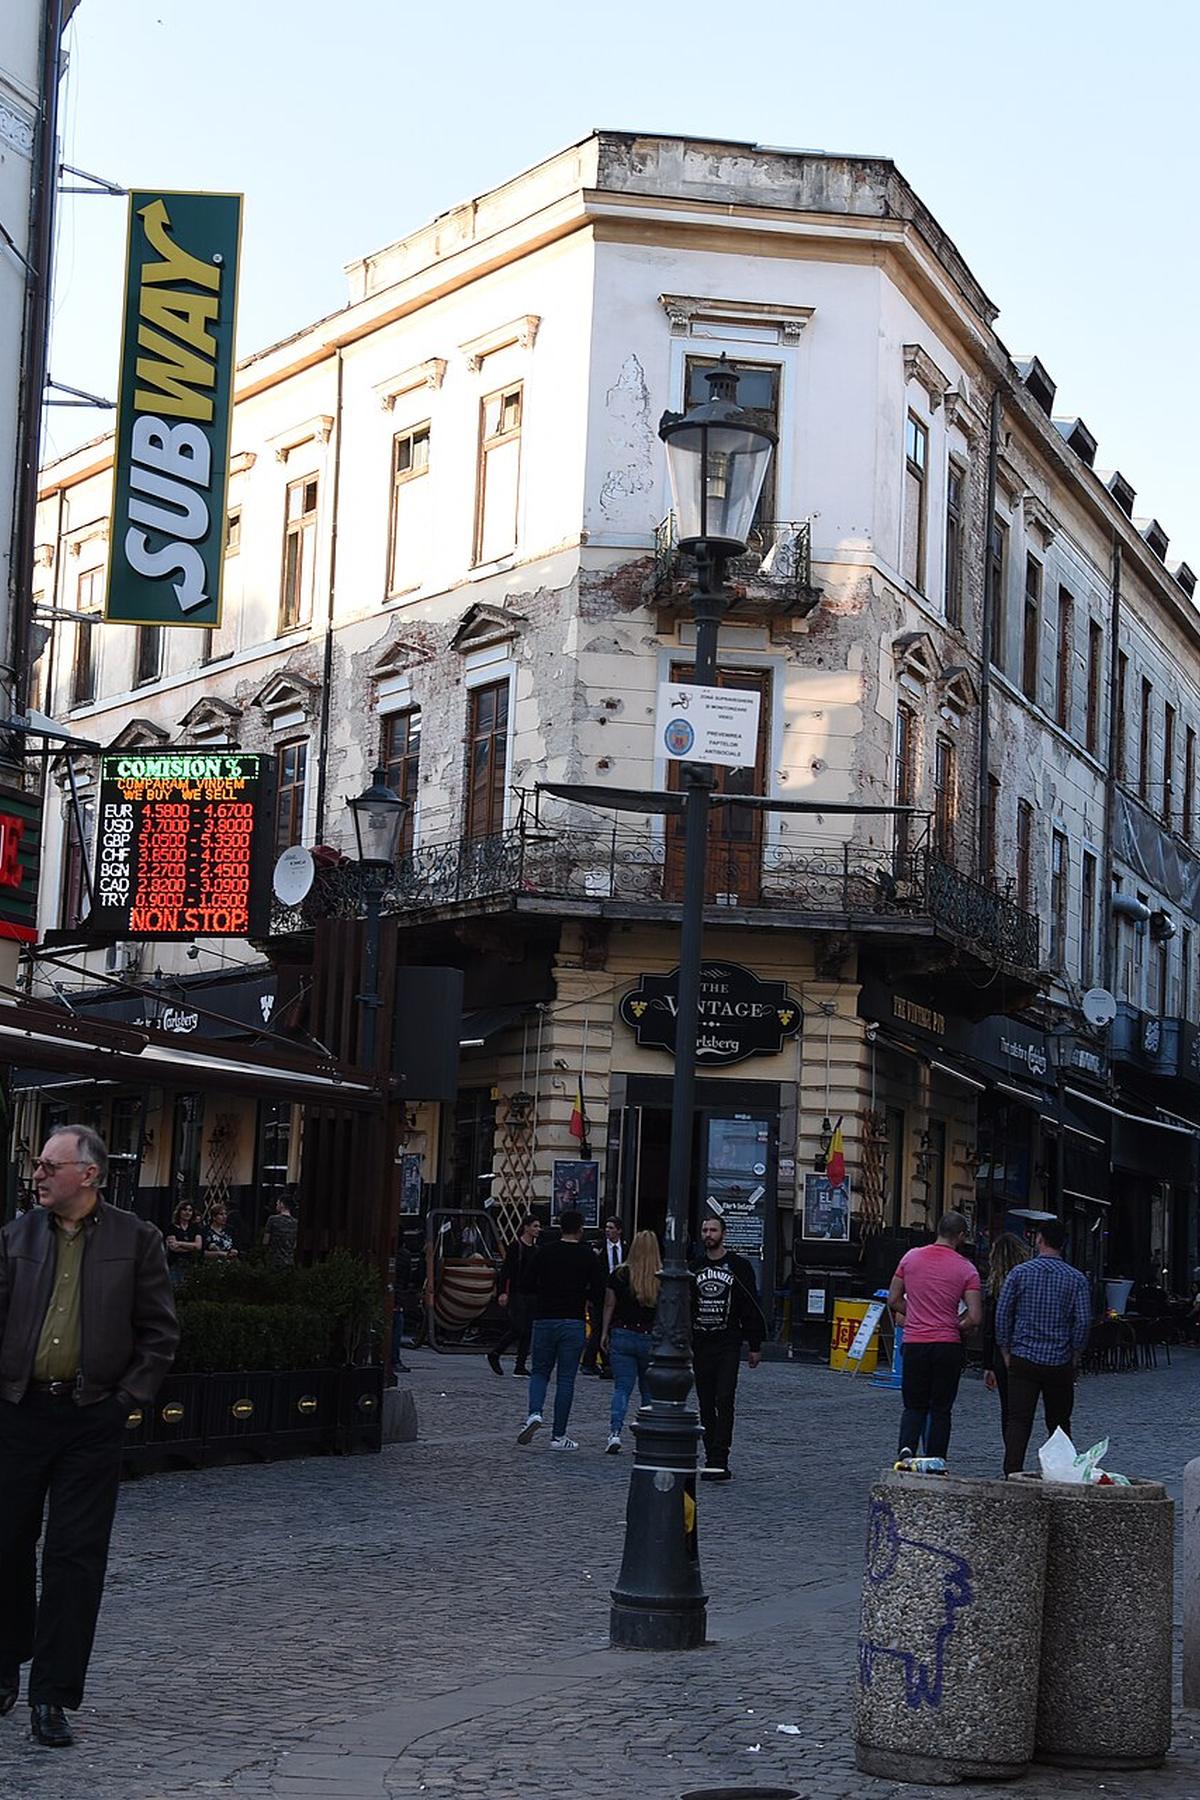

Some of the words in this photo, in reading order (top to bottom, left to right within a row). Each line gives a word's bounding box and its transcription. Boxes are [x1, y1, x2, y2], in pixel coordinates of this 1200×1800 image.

[124, 199, 222, 612] SUBWAY
[117, 759, 221, 778] COMISION
[117, 778, 189, 790] COMPARAM
[197, 778, 245, 790] VINDEM
[123, 789, 142, 800] WE
[146, 789, 171, 800] BUY
[181, 789, 201, 800] WE
[205, 789, 237, 800] SELL
[104, 804, 134, 818] EUR
[141, 804, 190, 818] 4.5800
[204, 804, 253, 818] 4.6700
[104, 819, 134, 833] USD
[142, 819, 190, 833] 3.7000
[204, 819, 253, 833] 3.8000
[103, 834, 131, 847] GBP
[138, 834, 187, 848] 5.0500
[201, 834, 250, 848] 5.3500
[102, 848, 130, 861] CHF
[201, 849, 250, 862] 4.0500
[100, 863, 130, 877] BGN
[137, 863, 186, 877] 2.2700
[200, 863, 249, 877] 2.4500
[100, 878, 130, 892] CAD
[137, 878, 186, 892] 2.8200
[200, 879, 249, 893] 3.0900
[99, 893, 129, 906] TRY
[136, 893, 184, 907] 0.9000
[199, 894, 247, 907] 1.0500
[132, 908, 178, 930] NON
[184, 908, 246, 931] STOP
[700, 982, 729, 994] THE
[163, 1007, 199, 1032] Carlsberg
[696, 1035, 740, 1053] rlsberg
